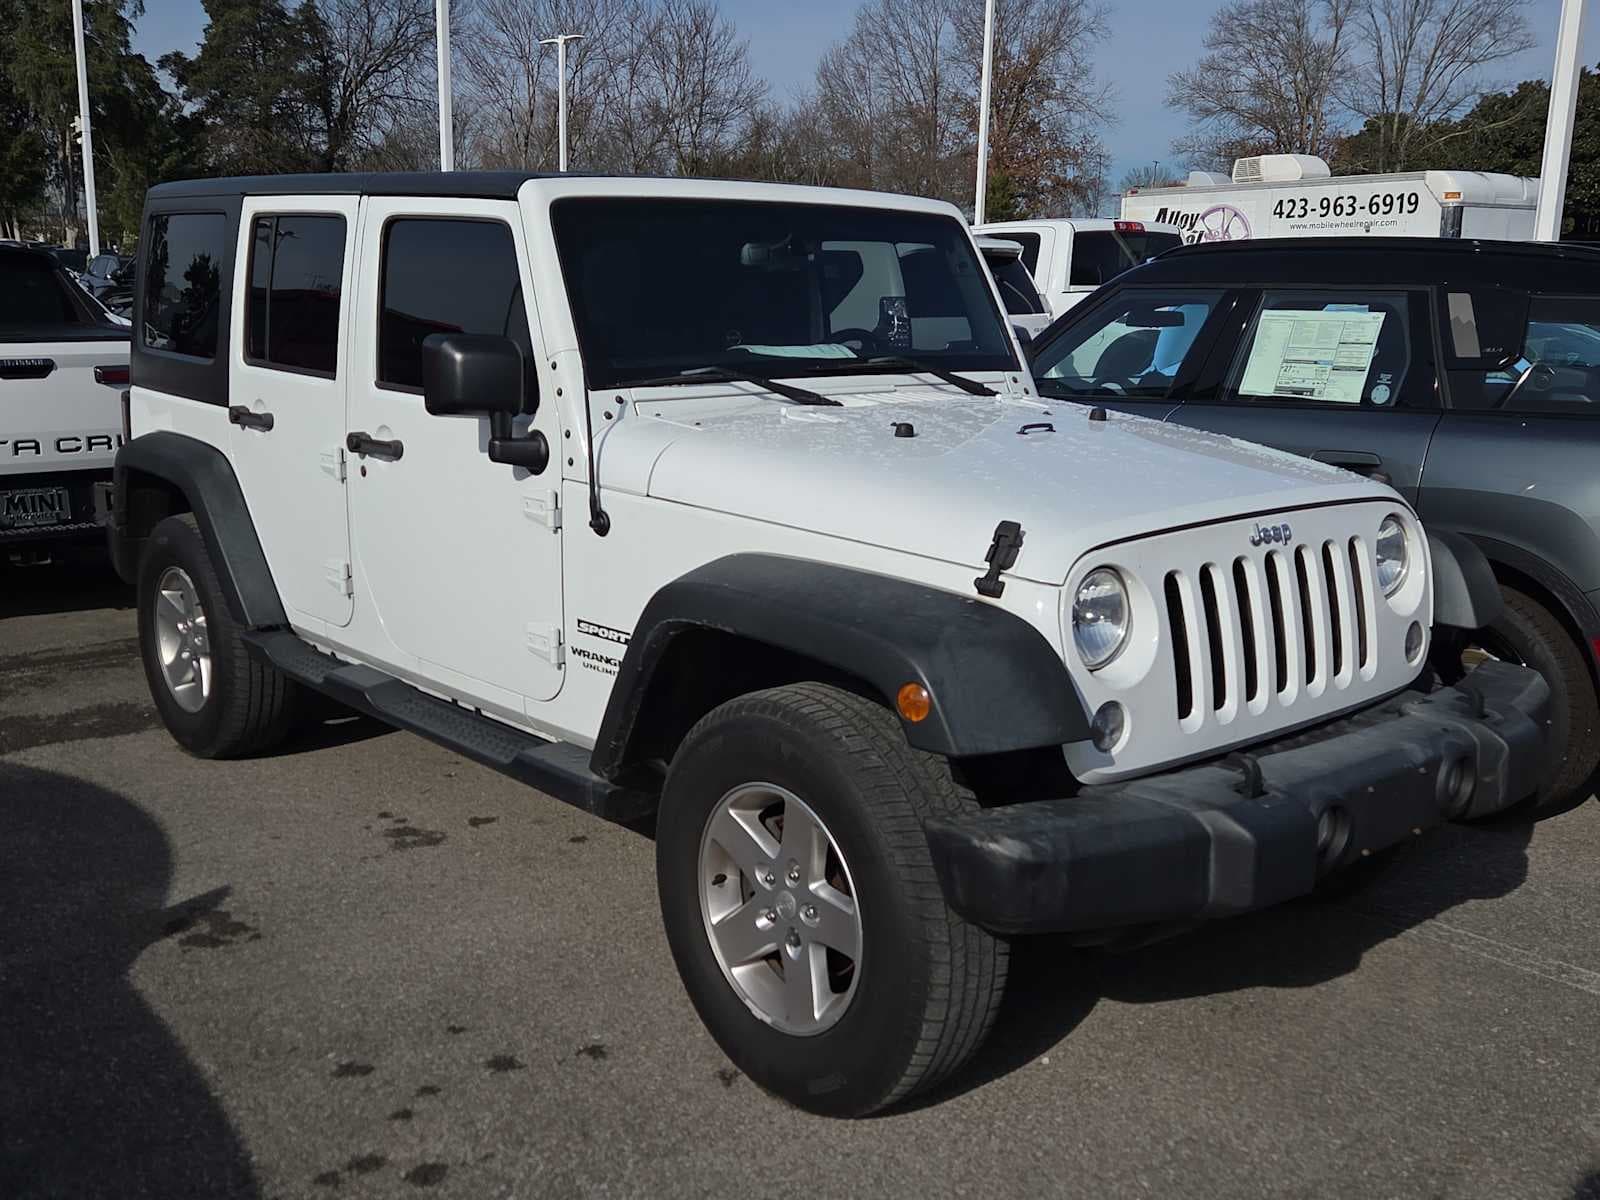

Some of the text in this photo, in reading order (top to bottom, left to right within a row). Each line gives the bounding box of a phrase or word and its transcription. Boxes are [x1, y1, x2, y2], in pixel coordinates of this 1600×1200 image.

[1273, 192, 1419, 219] 423-963-6919
[1155, 207, 1200, 232] Alloy
[56, 435, 122, 453] CR
[4, 492, 64, 515] MINI
[1249, 523, 1292, 547] Jeep
[577, 621, 631, 643] SPORT
